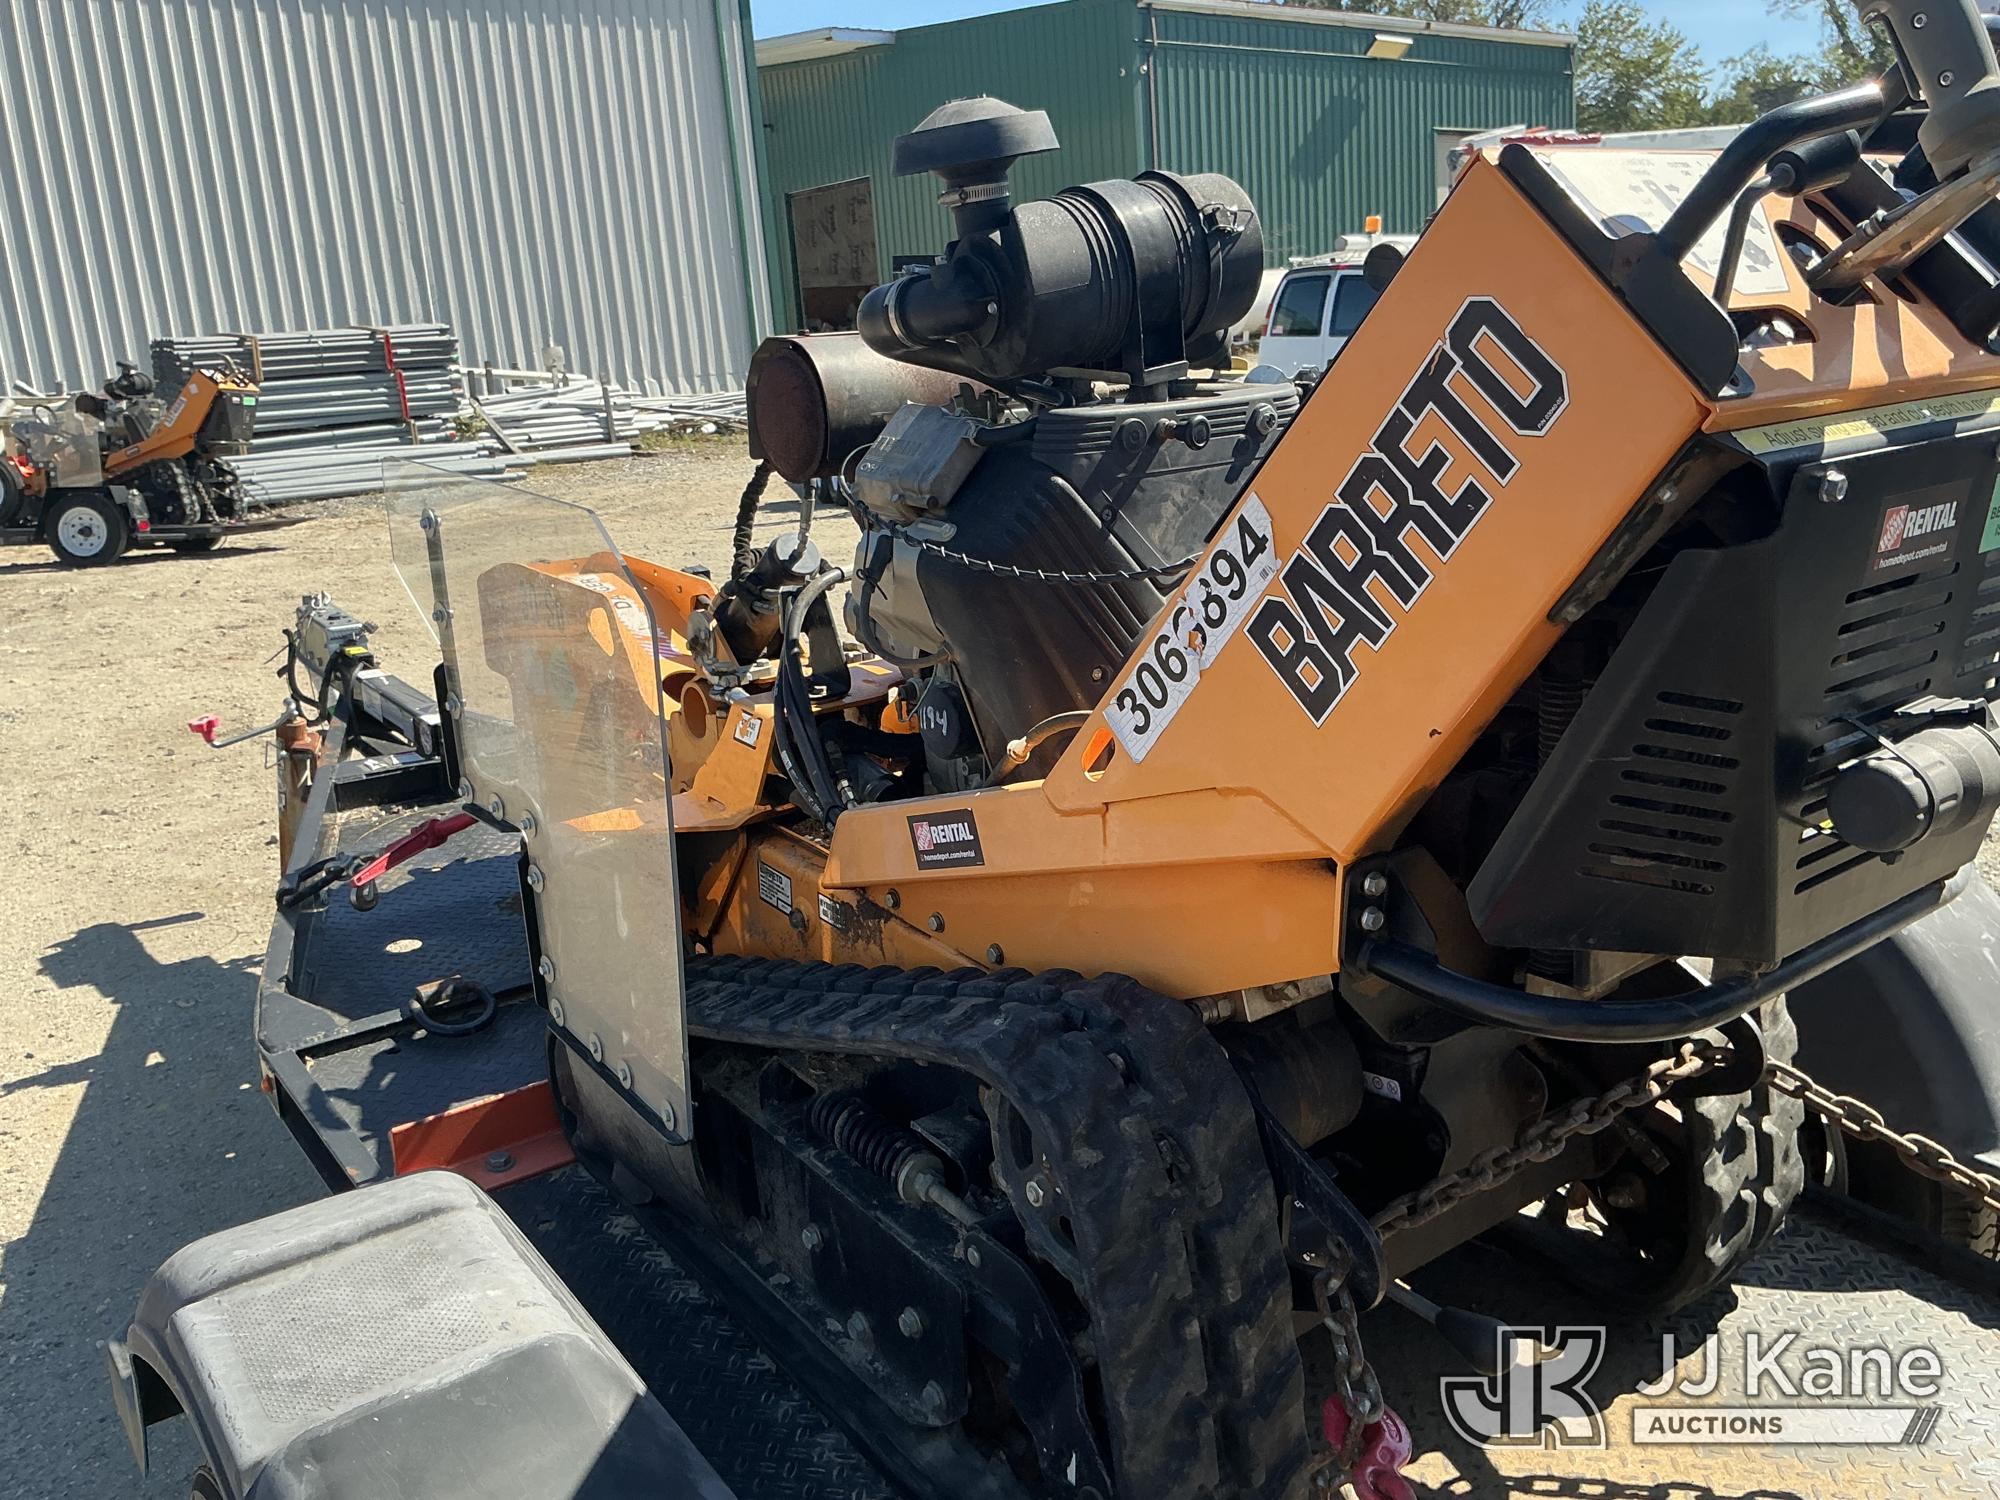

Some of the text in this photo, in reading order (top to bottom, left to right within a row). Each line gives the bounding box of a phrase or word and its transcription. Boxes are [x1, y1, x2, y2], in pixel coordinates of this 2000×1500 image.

[1762, 426, 1811, 448] Adjust
[1808, 420, 1850, 438] swing
[1850, 412, 1887, 434] speed
[1885, 408, 1912, 425] and
[1927, 400, 1961, 417] depth
[1956, 398, 1975, 412] to
[1243, 295, 1570, 729] BARRETO
[1902, 501, 1957, 539] RENTAL
[1878, 541, 1948, 569] homedepot.com/rental
[930, 822, 974, 844] RENTAL
[924, 850, 976, 862] homedepot.com/rental
